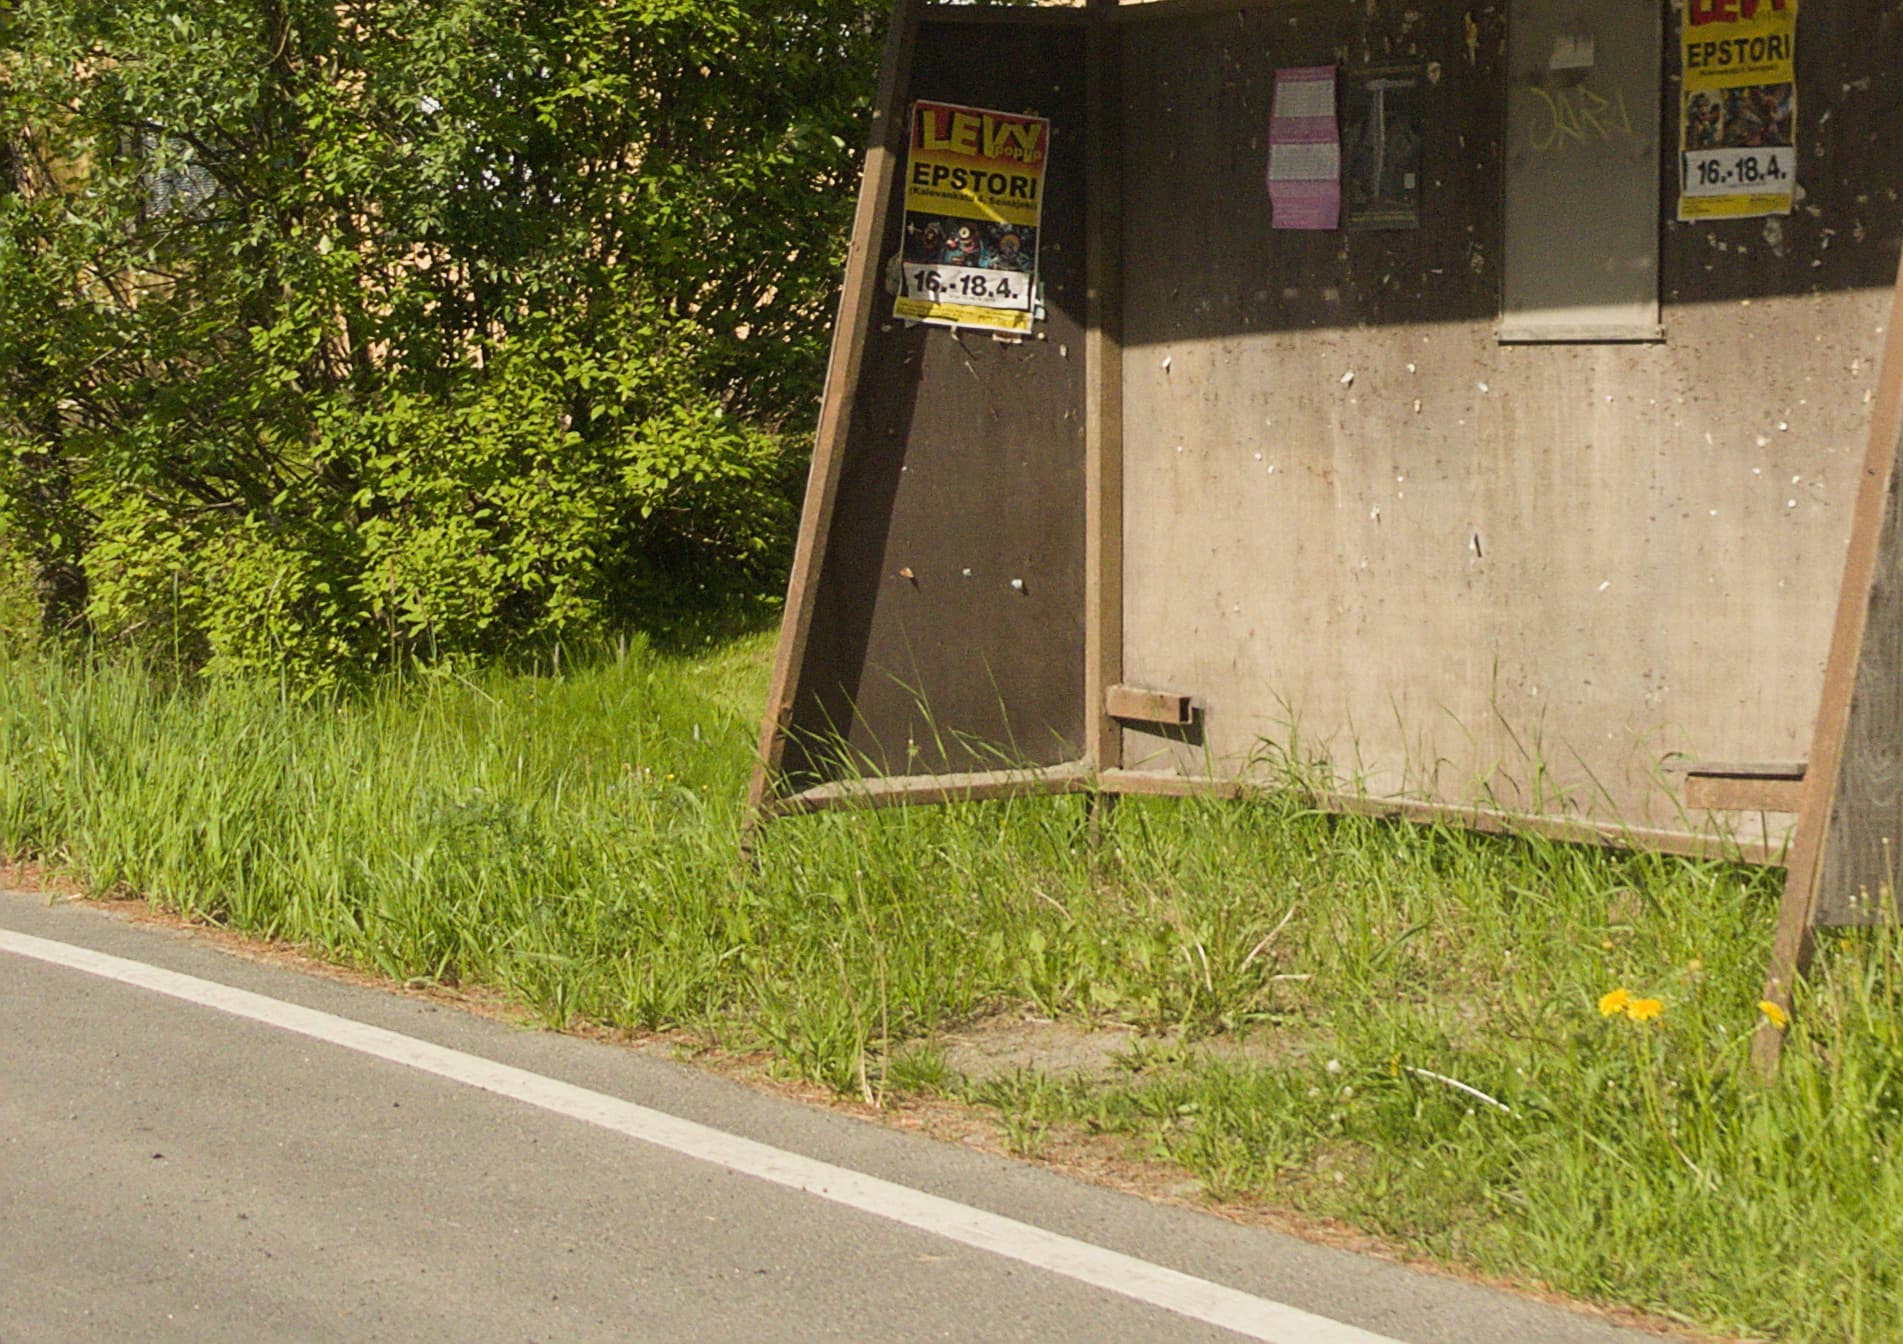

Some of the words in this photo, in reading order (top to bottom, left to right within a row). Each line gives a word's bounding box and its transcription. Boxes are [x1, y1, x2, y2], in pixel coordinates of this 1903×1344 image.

[1687, 34, 1790, 68] EPSTORI
[918, 110, 1041, 163] LEVY
[912, 162, 1037, 200] EPSTORI
[1697, 154, 1787, 185] 16.-18.4.
[914, 270, 1019, 299] 16.-18.4.
